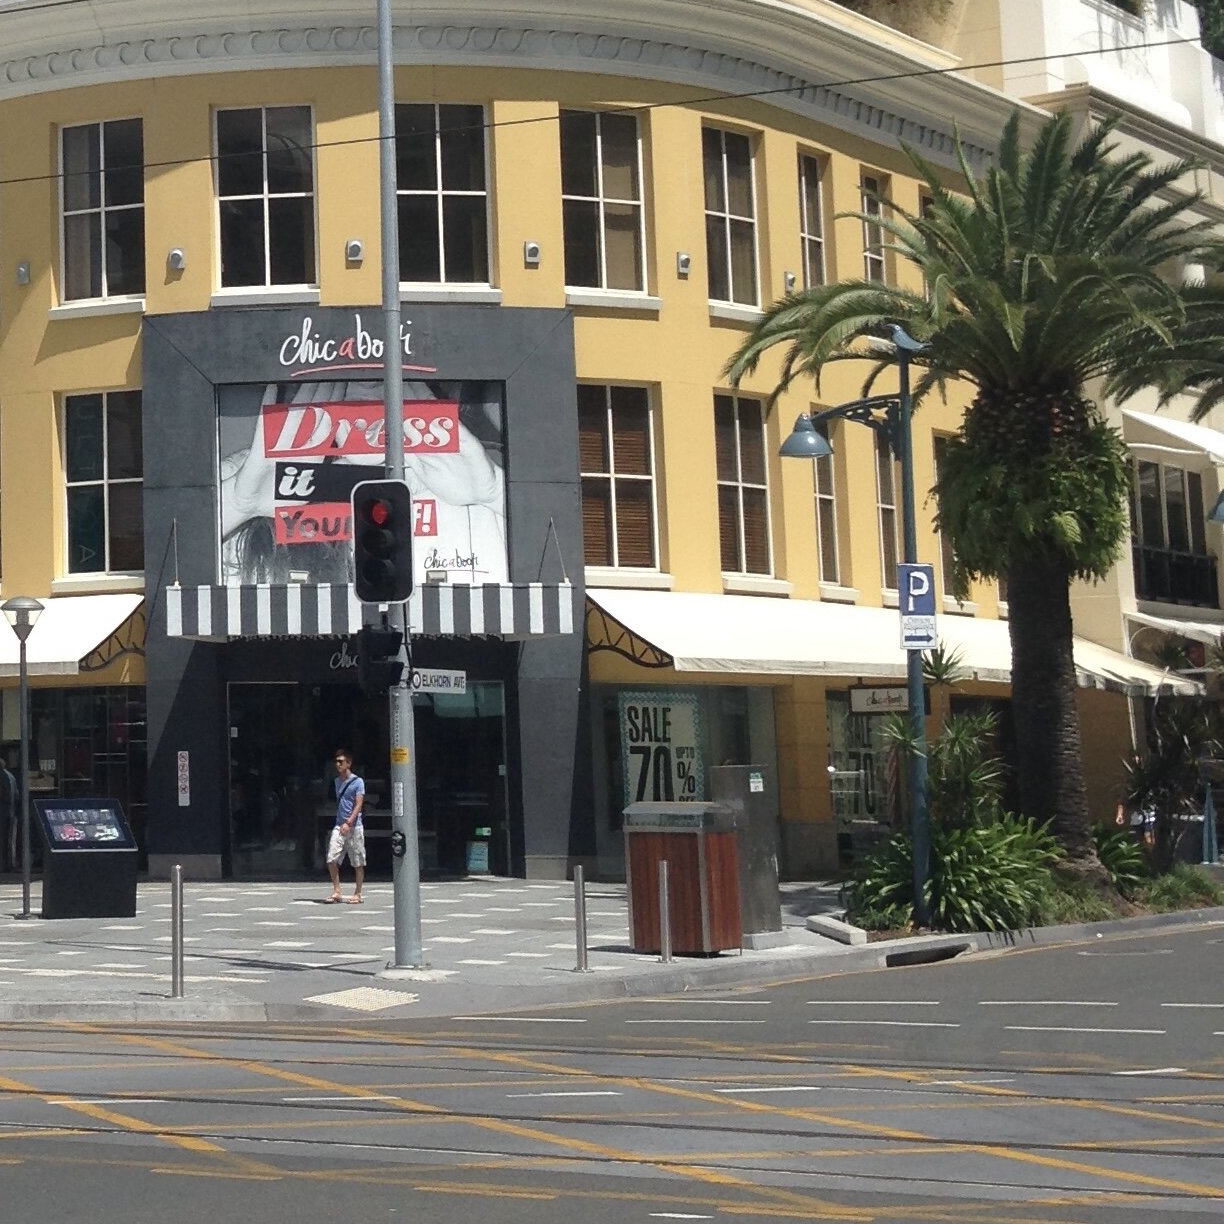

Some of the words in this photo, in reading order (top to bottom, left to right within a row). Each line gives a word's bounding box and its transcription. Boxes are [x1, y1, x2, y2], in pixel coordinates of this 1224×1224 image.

[268, 406, 454, 452] Dress
[278, 466, 316, 496] it
[908, 571, 929, 611] P
[422, 674, 451, 687] ELKHORN
[627, 706, 671, 743] SALE
[629, 745, 675, 803] 70
